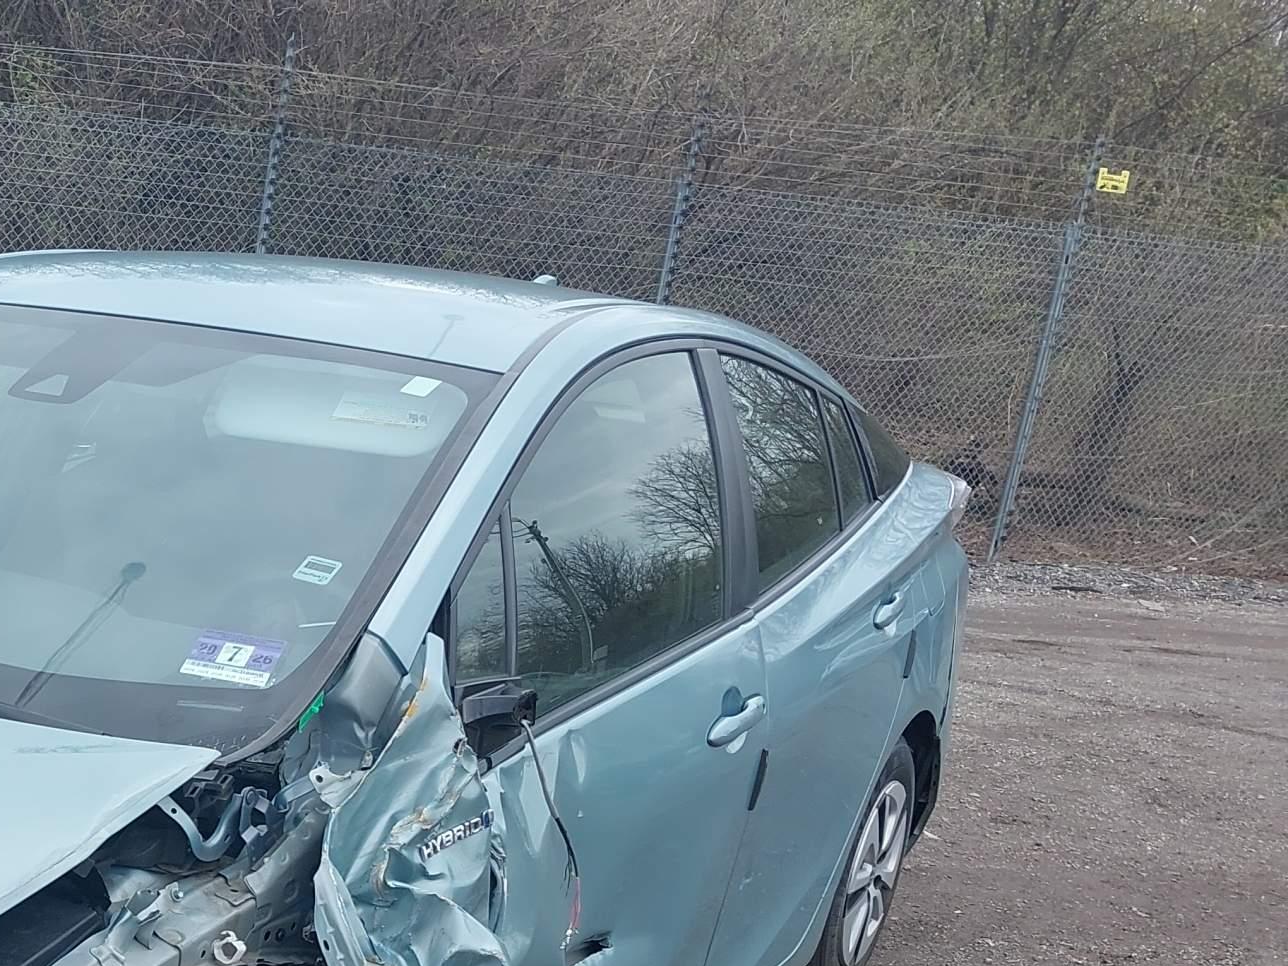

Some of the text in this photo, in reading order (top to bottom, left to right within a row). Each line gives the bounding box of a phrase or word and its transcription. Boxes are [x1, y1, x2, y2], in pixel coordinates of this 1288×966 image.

[227, 646, 243, 662] 7
[252, 654, 273, 665] 26
[419, 817, 483, 862] HYBRID
